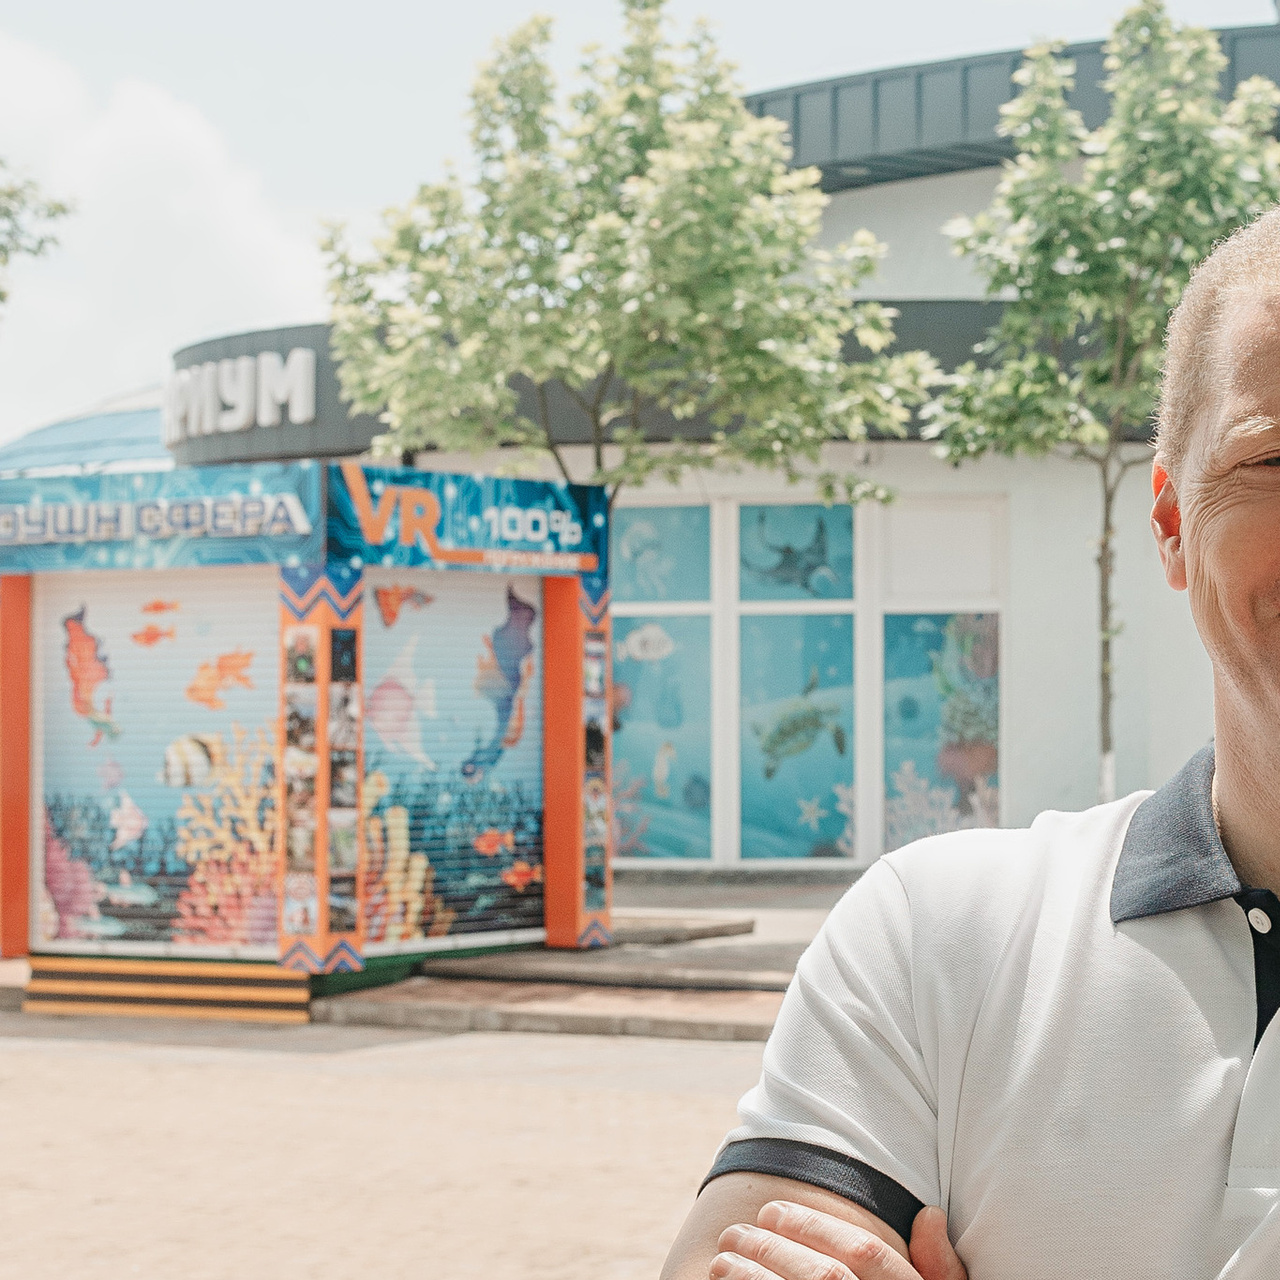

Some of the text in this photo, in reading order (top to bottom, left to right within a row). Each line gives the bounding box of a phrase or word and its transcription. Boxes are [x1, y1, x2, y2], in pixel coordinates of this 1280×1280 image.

[135, 492, 312, 539] СФЕРА
[341, 462, 582, 552] VR 100%
